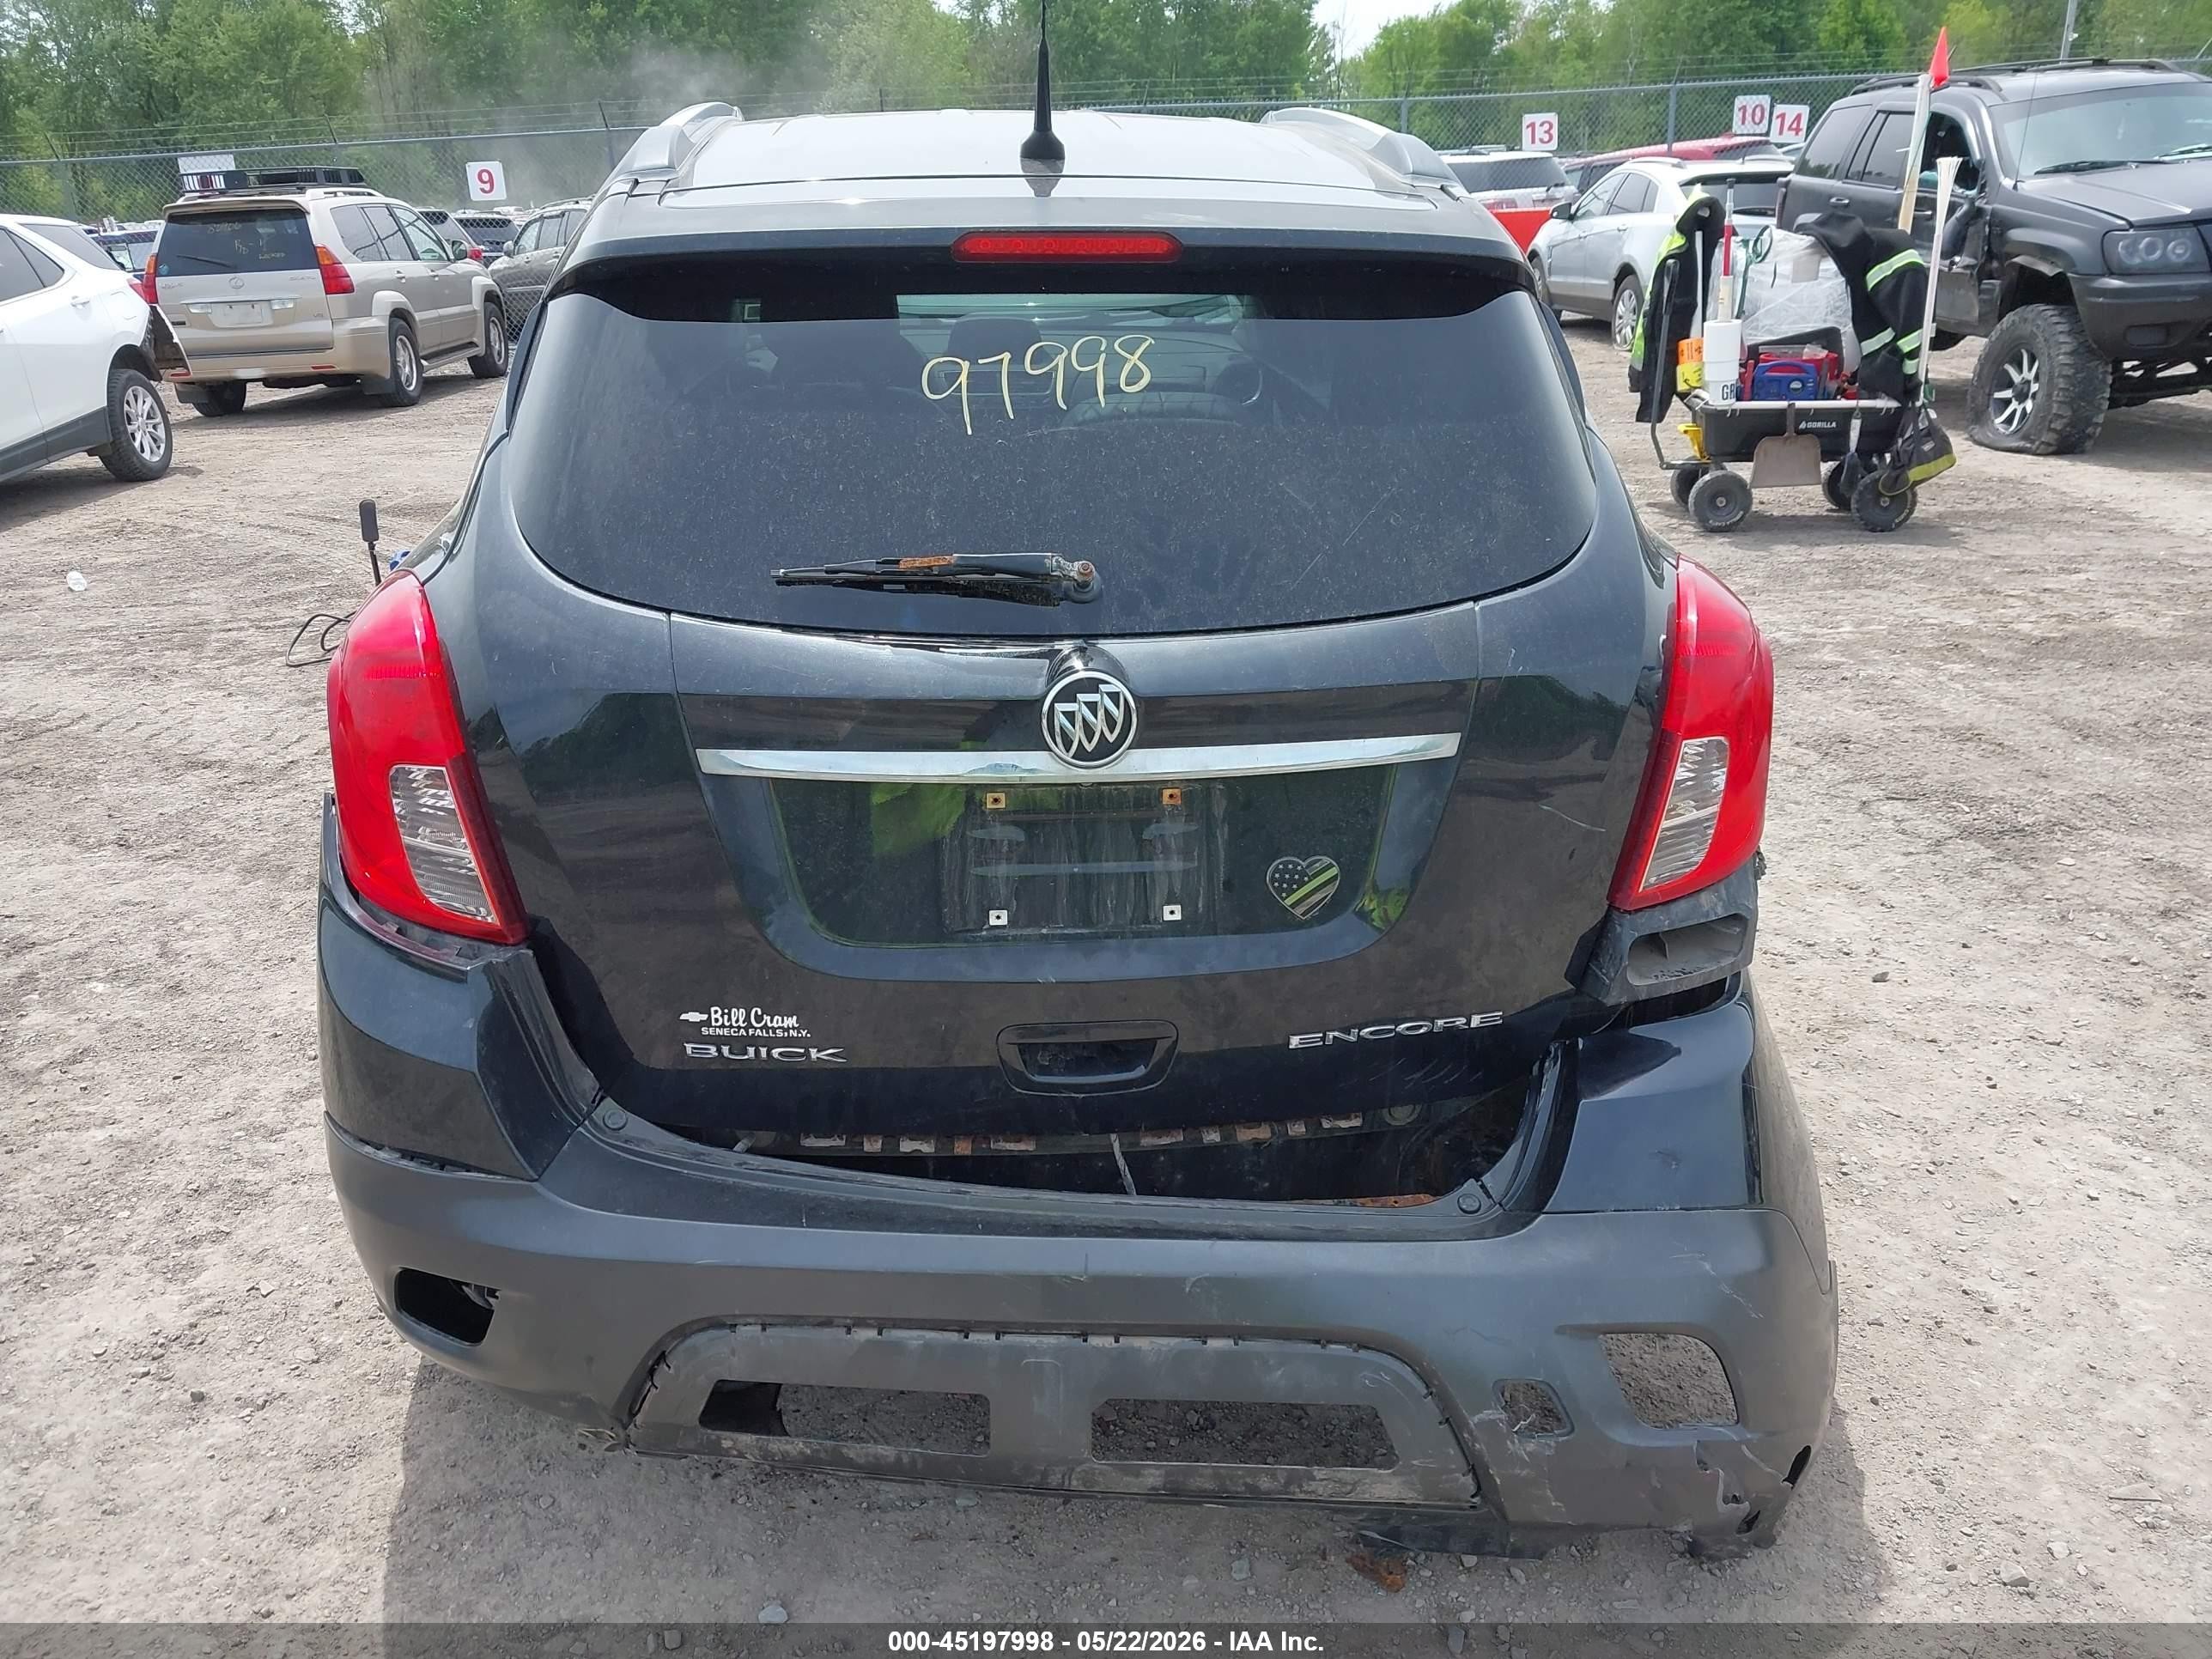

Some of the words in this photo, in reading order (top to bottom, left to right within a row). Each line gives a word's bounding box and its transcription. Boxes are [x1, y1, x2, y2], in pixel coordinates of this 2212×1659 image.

[1738, 104, 1765, 125] 10
[1775, 112, 1803, 136] 14
[1526, 120, 1553, 144] 13
[477, 168, 495, 194] 9
[921, 334, 1155, 435] 97998
[710, 1006, 748, 1027] Bill
[750, 1007, 799, 1028] Cram
[701, 1027, 747, 1036] SENECA
[749, 1029, 787, 1037] FALLS,
[789, 1029, 811, 1037] N.Y.
[1288, 1011, 1504, 1049] ENCORE
[684, 1042, 848, 1062] BUICK
